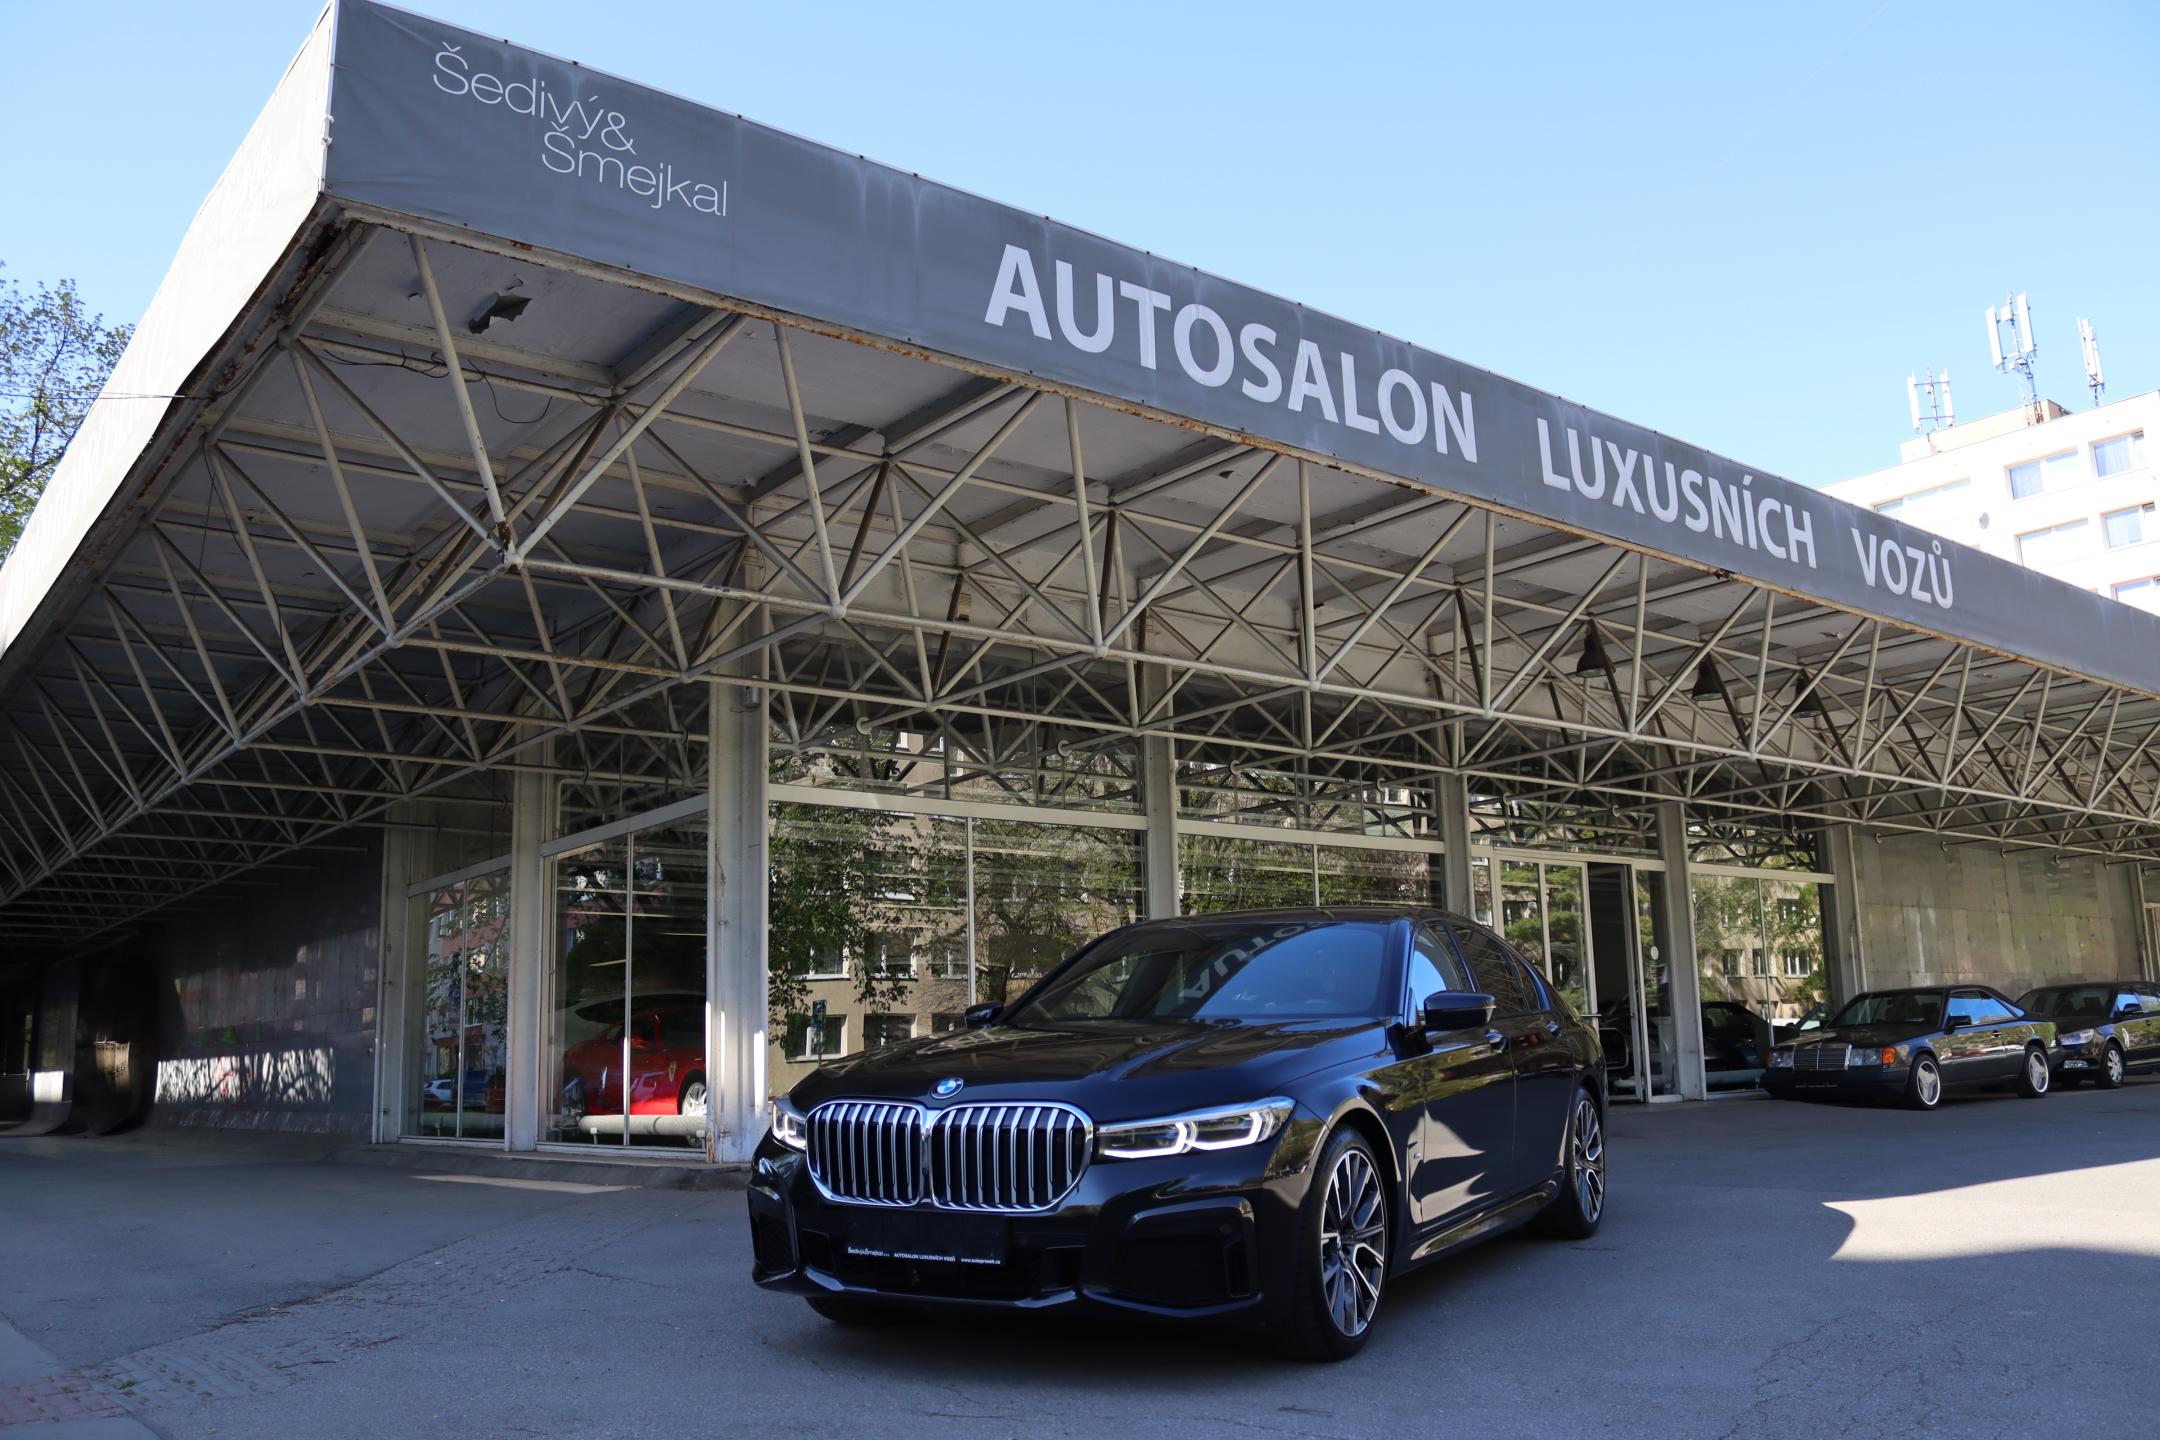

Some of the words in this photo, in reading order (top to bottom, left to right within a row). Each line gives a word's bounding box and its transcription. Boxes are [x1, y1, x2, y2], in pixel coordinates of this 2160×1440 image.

[541, 125, 727, 217] Šmejkal
[985, 243, 1478, 463] AUTOSALON
[1537, 418, 1817, 569] LUXUSNÍCH
[1851, 527, 1954, 609] VOZŮ
